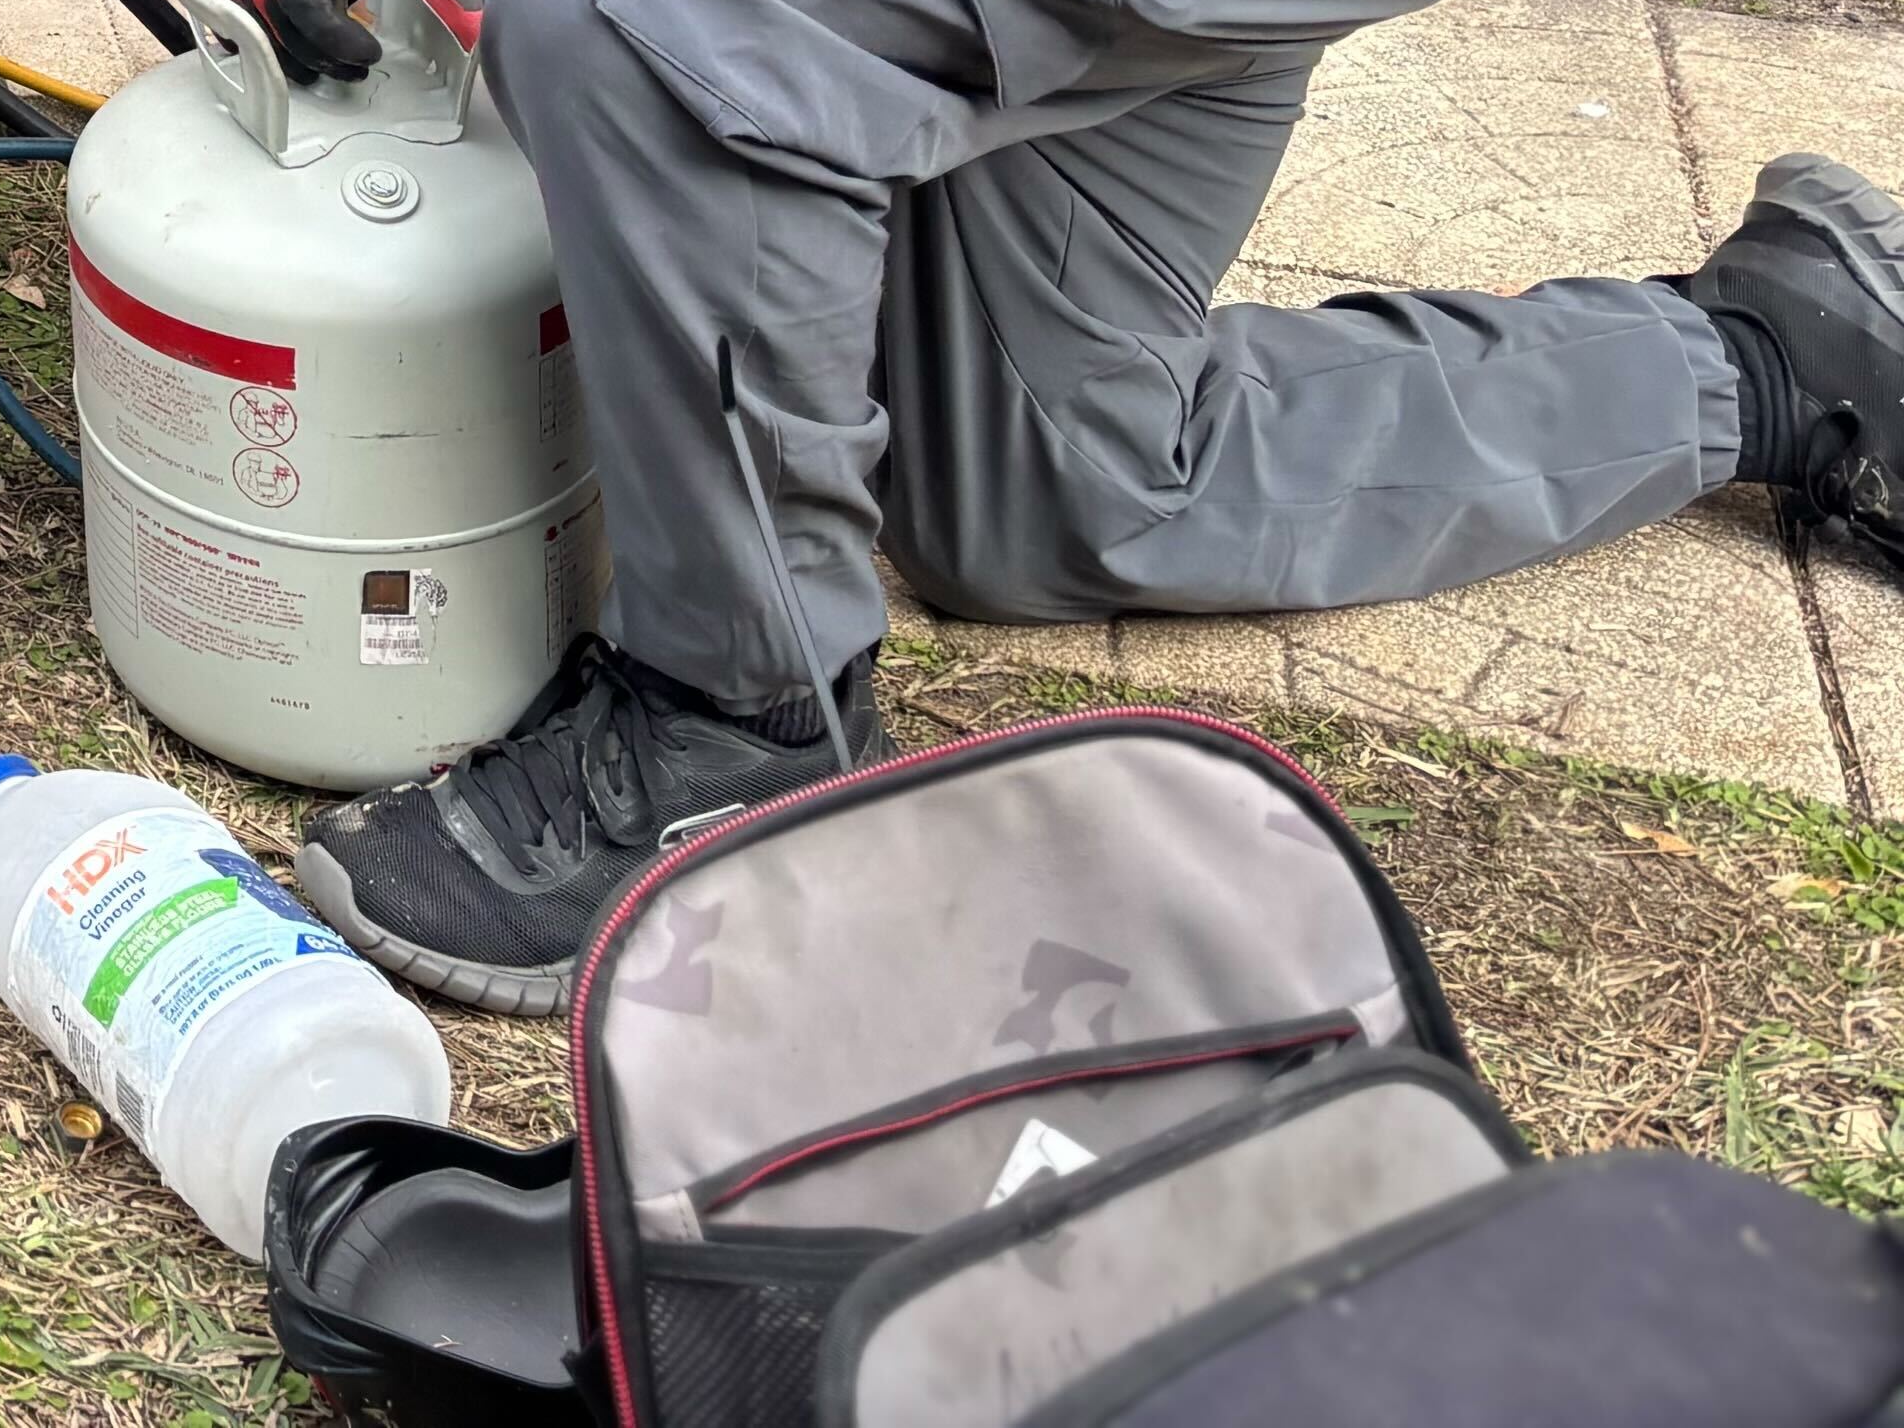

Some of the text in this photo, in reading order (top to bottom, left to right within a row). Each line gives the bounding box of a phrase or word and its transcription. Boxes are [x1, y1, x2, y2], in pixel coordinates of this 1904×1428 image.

[47, 828, 149, 915] HDX
[79, 869, 146, 930] Cleaning
[88, 886, 147, 941] Vinegar
